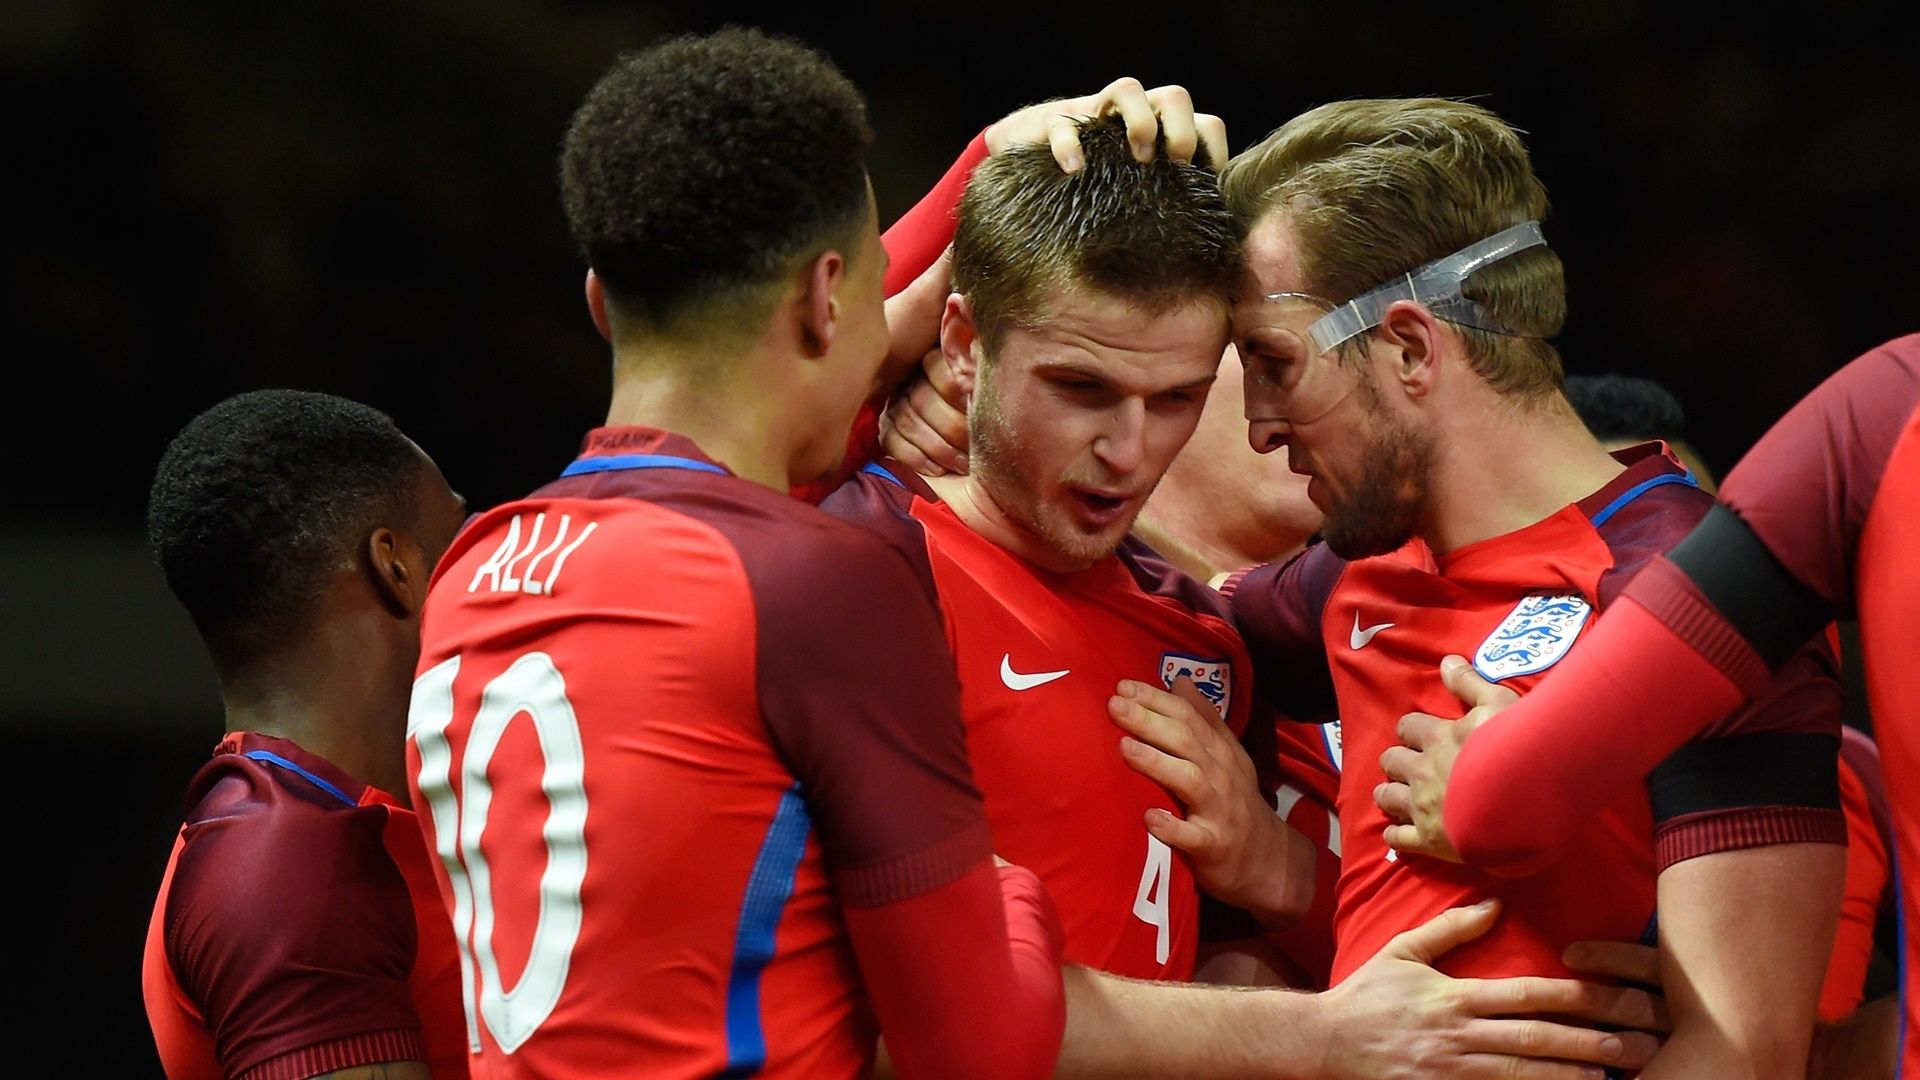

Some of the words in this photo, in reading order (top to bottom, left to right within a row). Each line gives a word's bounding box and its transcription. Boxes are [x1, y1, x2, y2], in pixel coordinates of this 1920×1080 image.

[468, 513, 598, 594] ALLI
[406, 652, 588, 1055] 10
[1133, 809, 1172, 965] 4
